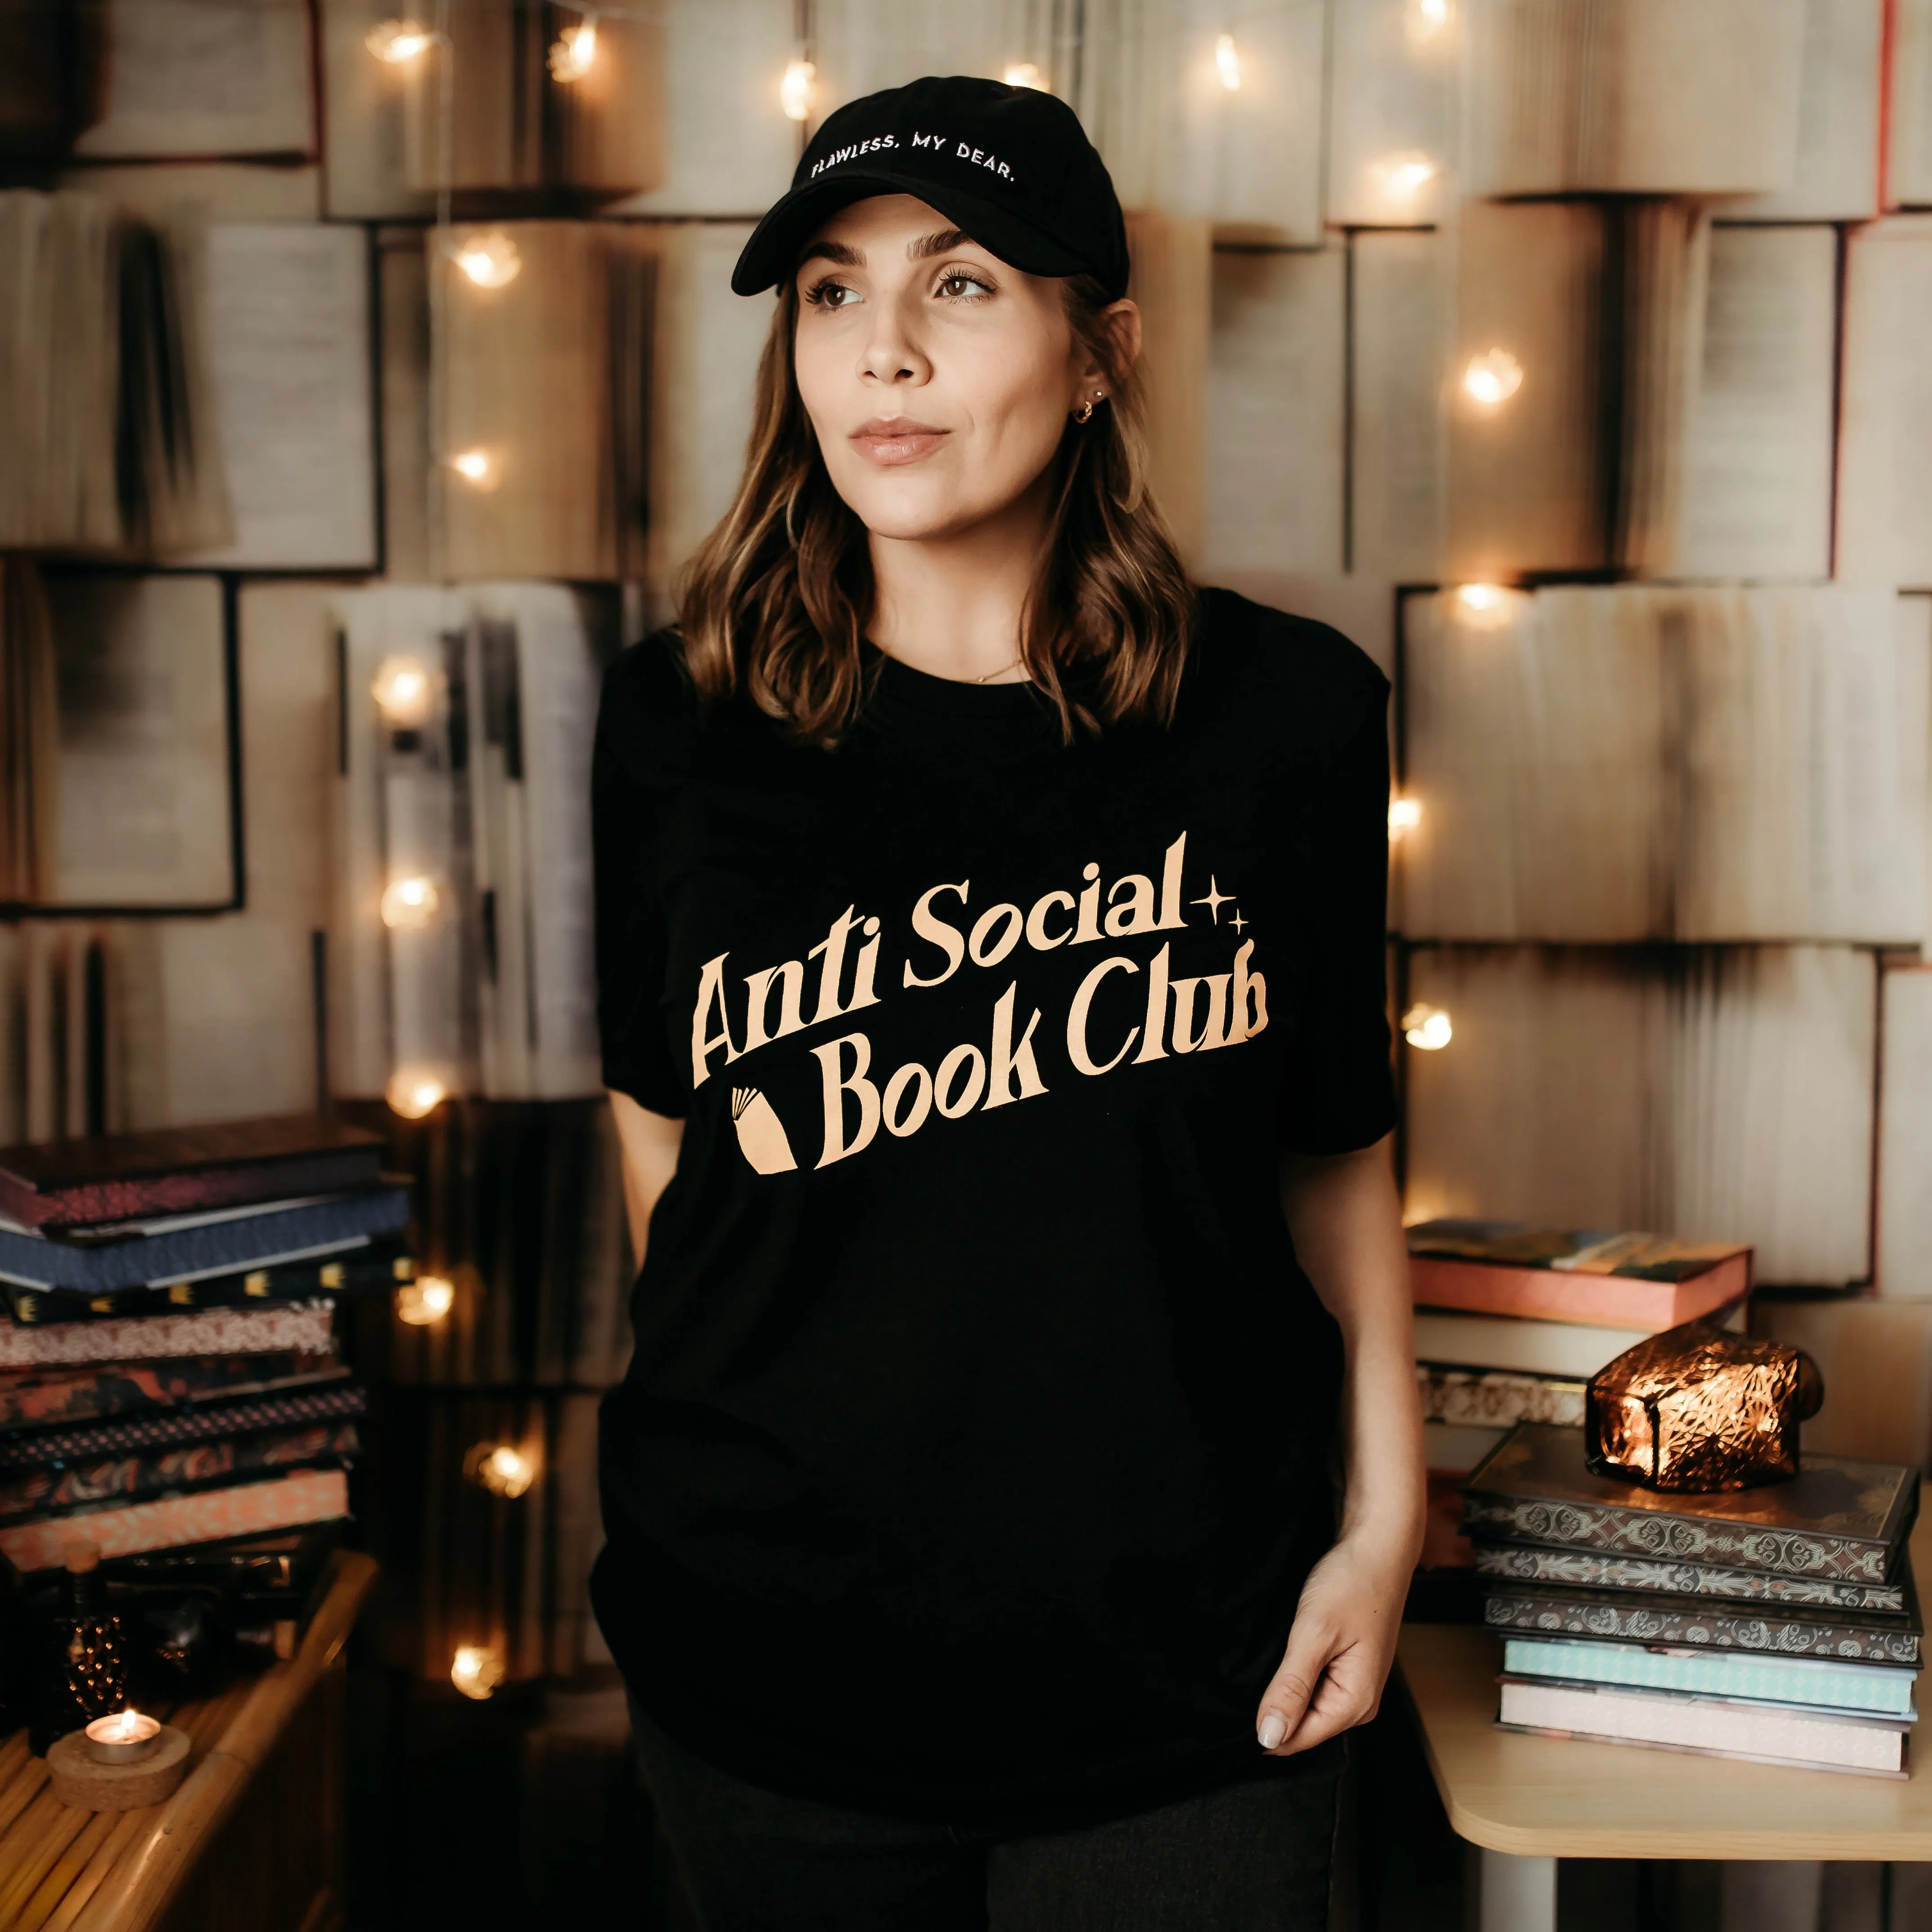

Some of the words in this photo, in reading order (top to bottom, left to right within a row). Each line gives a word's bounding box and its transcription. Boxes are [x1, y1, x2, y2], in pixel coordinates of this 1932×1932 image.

[912, 131, 946, 150] MY
[956, 142, 1015, 182] DEAR.
[692, 904, 882, 1090] Anti
[903, 830, 1189, 989] Social
[809, 980, 1050, 1170] Book
[1066, 938, 1269, 1075] Club
